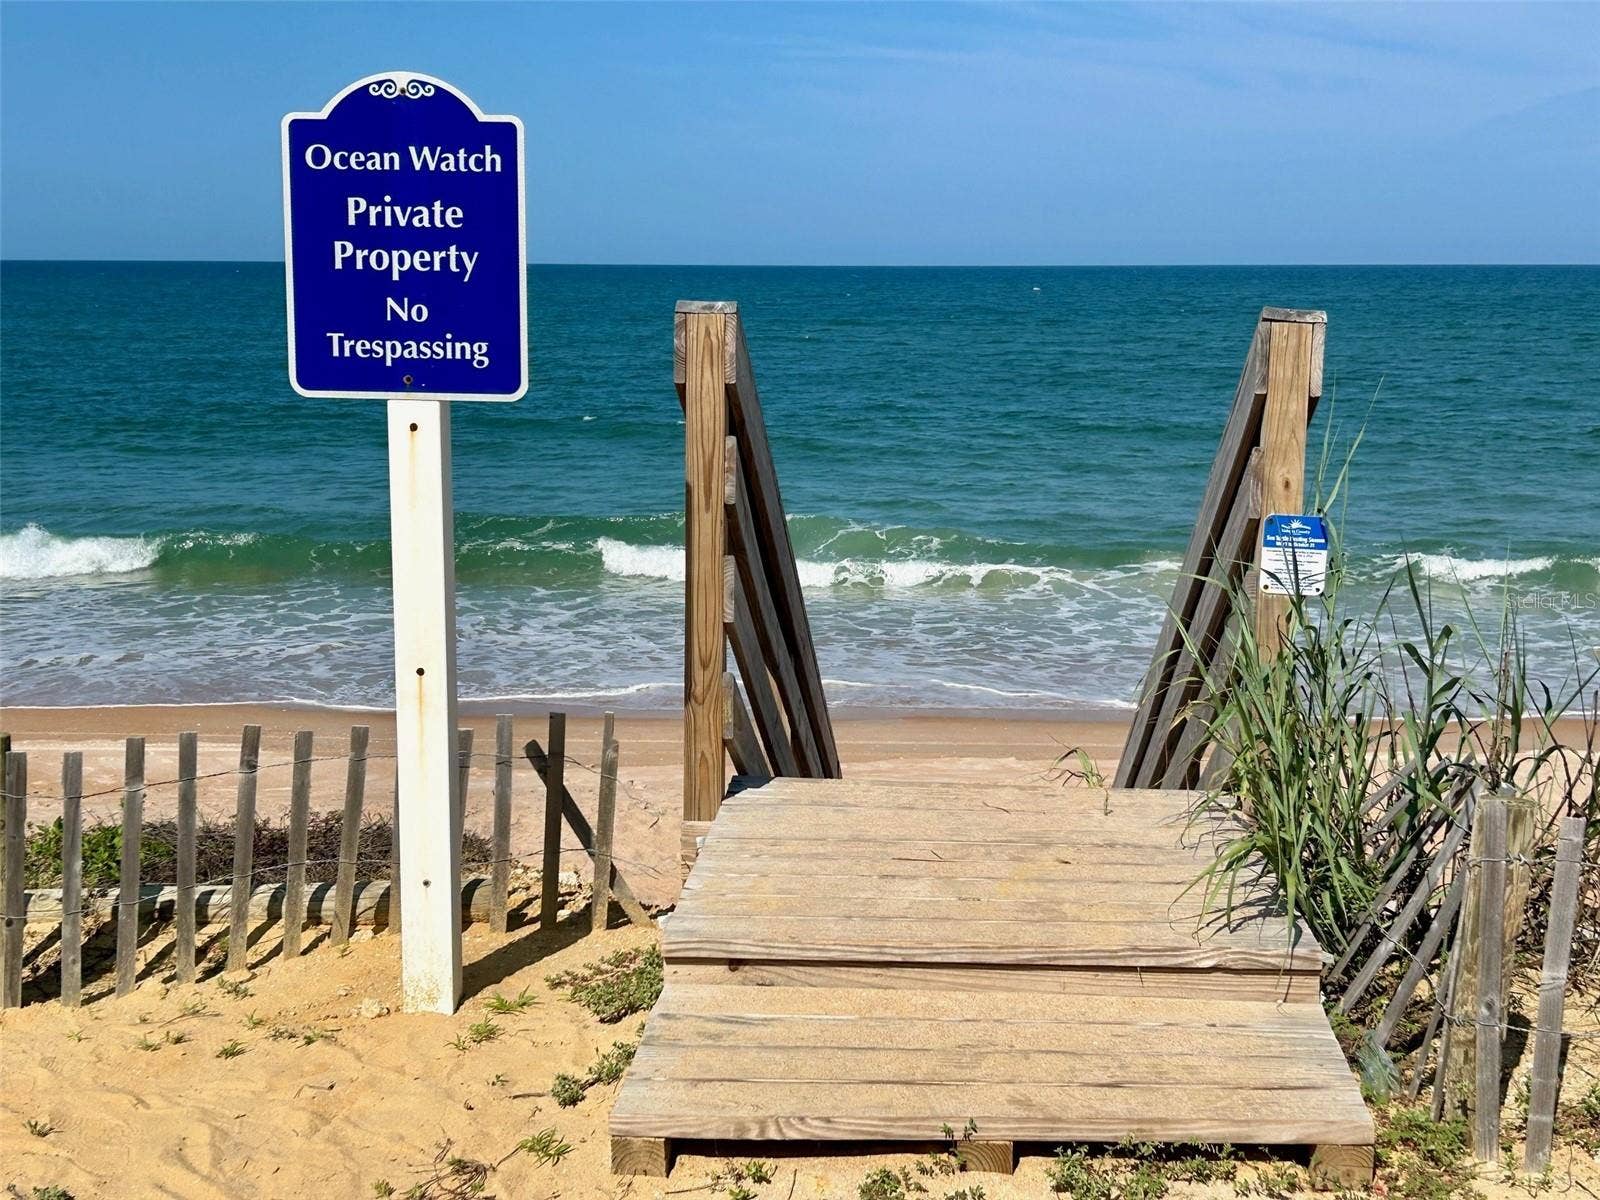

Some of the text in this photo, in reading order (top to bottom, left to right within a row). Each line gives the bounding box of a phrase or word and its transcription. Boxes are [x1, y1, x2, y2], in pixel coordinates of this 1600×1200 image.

[305, 143, 503, 173] Ocean Watch
[347, 195, 464, 228] Private
[334, 240, 479, 282] Property
[386, 297, 429, 323] No
[326, 332, 490, 369] Trespassing
